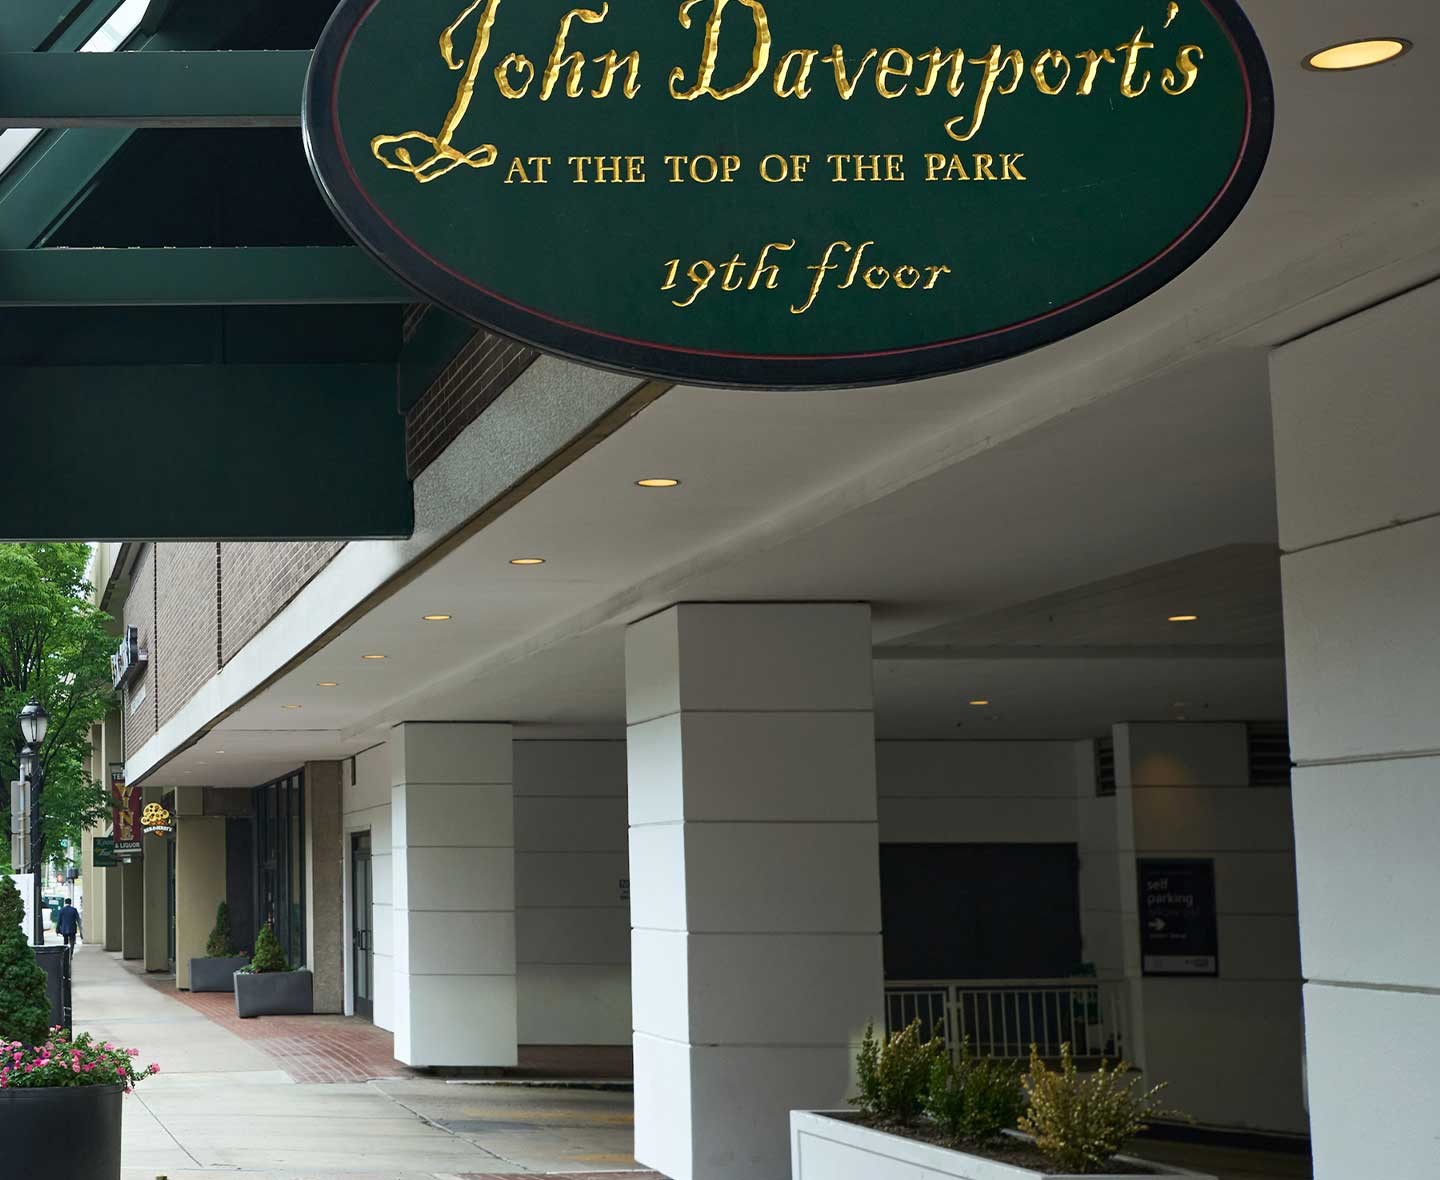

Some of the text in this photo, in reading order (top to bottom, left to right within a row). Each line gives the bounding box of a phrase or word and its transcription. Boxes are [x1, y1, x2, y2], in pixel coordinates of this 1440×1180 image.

[370, 0, 1205, 184] John Davenport's
[504, 153, 1027, 184] AT THE TOP OF THE PARK
[661, 240, 952, 314] 19th floor
